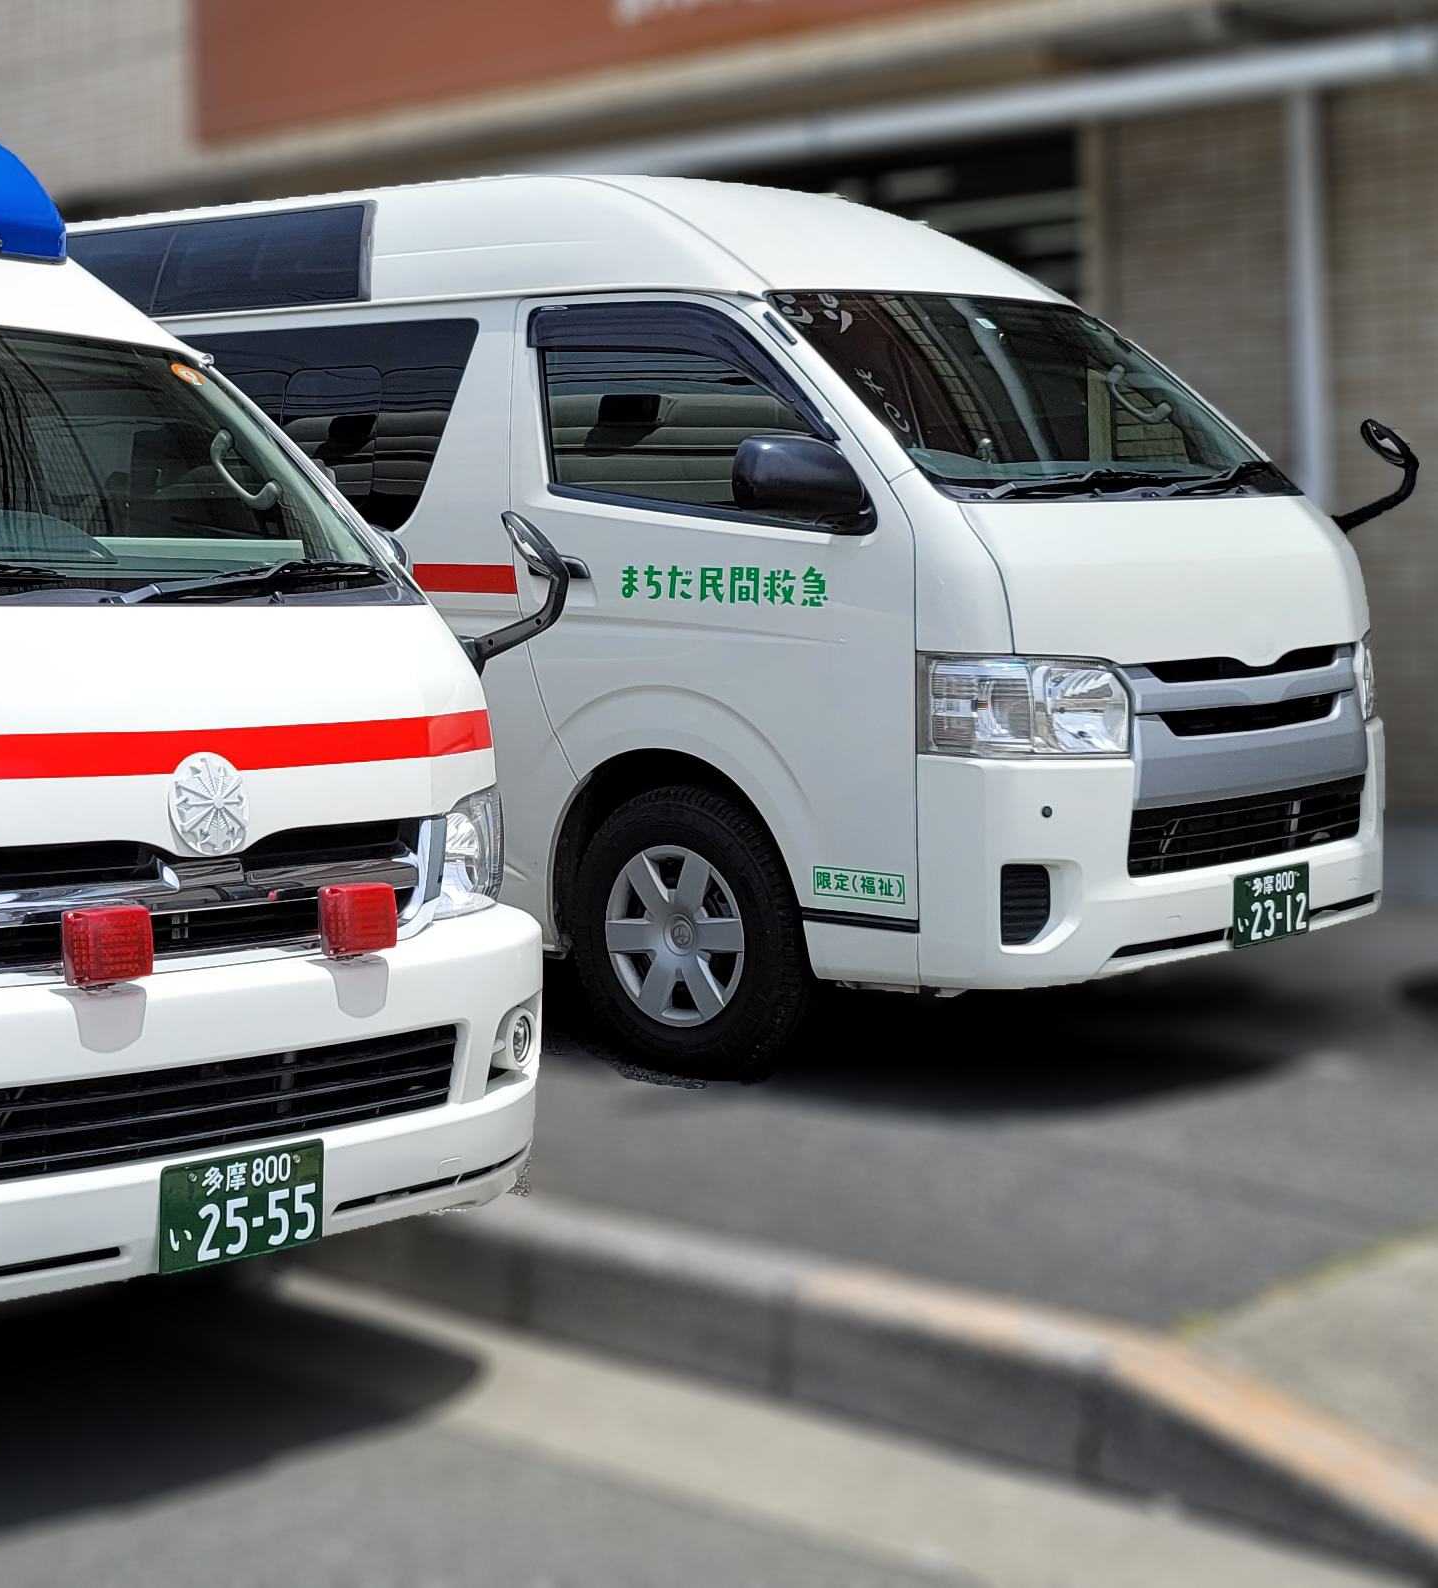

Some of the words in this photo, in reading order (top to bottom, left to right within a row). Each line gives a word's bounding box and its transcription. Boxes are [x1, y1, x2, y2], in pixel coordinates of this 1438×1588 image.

[621, 564, 829, 608] まちだ民間救急
[815, 871, 903, 898] 限定(福祉)
[1252, 875, 1274, 897] 多摩
[1275, 870, 1295, 892] 800
[1237, 917, 1250, 933] い
[1250, 892, 1307, 941] 23-12
[201, 1162, 248, 1197] 多摩
[251, 1153, 291, 1187] 800
[169, 1228, 193, 1252] い
[197, 1182, 316, 1262] 25-55
